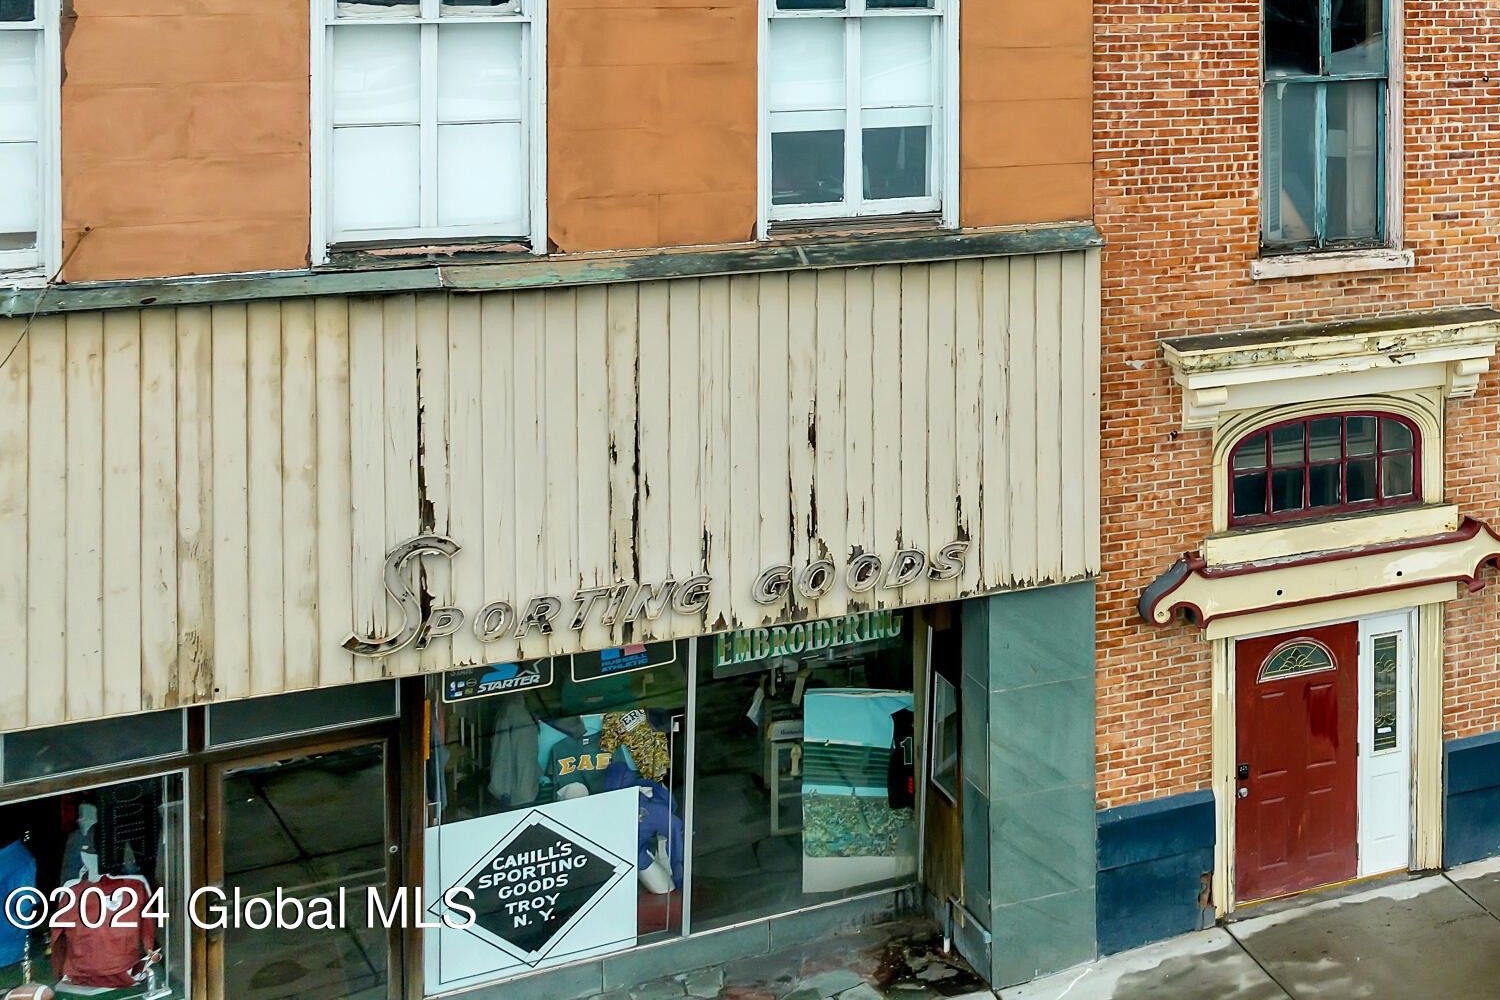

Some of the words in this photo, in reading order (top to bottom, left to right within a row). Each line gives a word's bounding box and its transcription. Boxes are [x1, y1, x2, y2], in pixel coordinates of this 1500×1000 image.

[752, 541, 970, 605] GOODS
[717, 609, 904, 667] EMBROIDERING
[477, 674, 541, 693] STARTER
[492, 841, 573, 871] CAHILL'S
[478, 854, 588, 889] SPORTING
[498, 873, 569, 899] GOODS
[504, 892, 560, 915] TROY
[513, 913, 533, 928] N.
[538, 907, 556, 922] Y.
